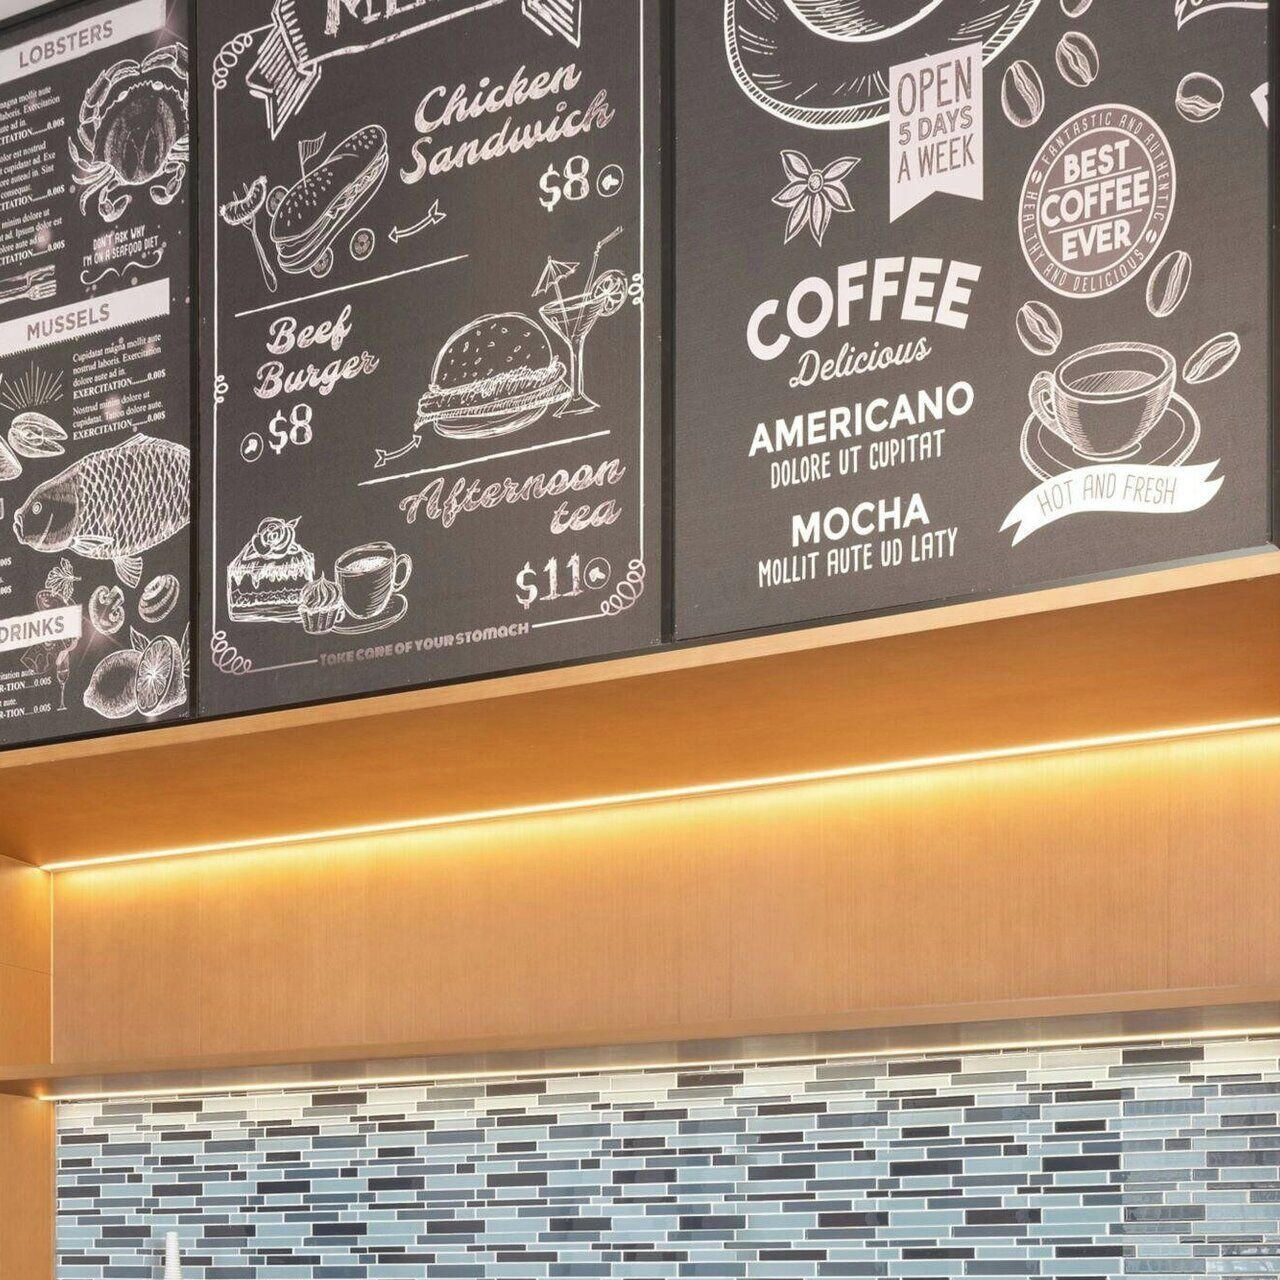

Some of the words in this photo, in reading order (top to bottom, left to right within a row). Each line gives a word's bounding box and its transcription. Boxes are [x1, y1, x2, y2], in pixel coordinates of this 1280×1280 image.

[19, 20, 114, 68] LOBSTERS
[414, 63, 582, 134] Chicken
[897, 56, 972, 117] OPEN
[400, 88, 616, 185] Sandwich
[899, 122, 912, 146] 5
[918, 105, 973, 141] DAYS
[538, 154, 590, 212] $8
[897, 151, 911, 184] A
[918, 133, 975, 178] WEEK
[1041, 111, 1113, 166] FANTASTIC
[1119, 114, 1143, 136] AND
[1143, 132, 1170, 222] AUTHENTIC
[1063, 139, 1130, 185] BEST
[1040, 170, 1150, 228] COFFEE
[112, 241, 142, 260] SEAFOOD
[130, 225, 145, 240] WHY
[1023, 190, 1046, 265] HEALTHY
[1042, 262, 1068, 287] AND
[1072, 248, 1145, 292] DELICIOUS
[1062, 218, 1132, 262] EVER
[26, 303, 111, 341] MUSSELS
[266, 304, 353, 355] Beef
[746, 256, 982, 361] COFFEE
[253, 350, 380, 400] Burger
[788, 337, 932, 388] Delicious
[268, 403, 313, 456] $8
[748, 380, 975, 457] AMERICANO
[770, 452, 831, 489] DOLORE
[839, 445, 862, 476] UT
[869, 428, 946, 471] CUPITAT
[399, 457, 626, 528] Afternoon
[549, 498, 623, 536] tea
[1036, 479, 1073, 517] HOT
[1083, 472, 1116, 501] AND
[1123, 474, 1177, 505] FRESH
[792, 492, 930, 547] MOCHA
[515, 552, 583, 610] $11
[758, 551, 820, 588] MOLLIT
[827, 543, 873, 577] AUTE
[881, 538, 903, 567] UD
[911, 527, 958, 563] LATY
[320, 650, 354, 667] TAKE
[356, 644, 393, 661] CARE
[395, 641, 413, 655] OF
[414, 634, 454, 651] YOUR
